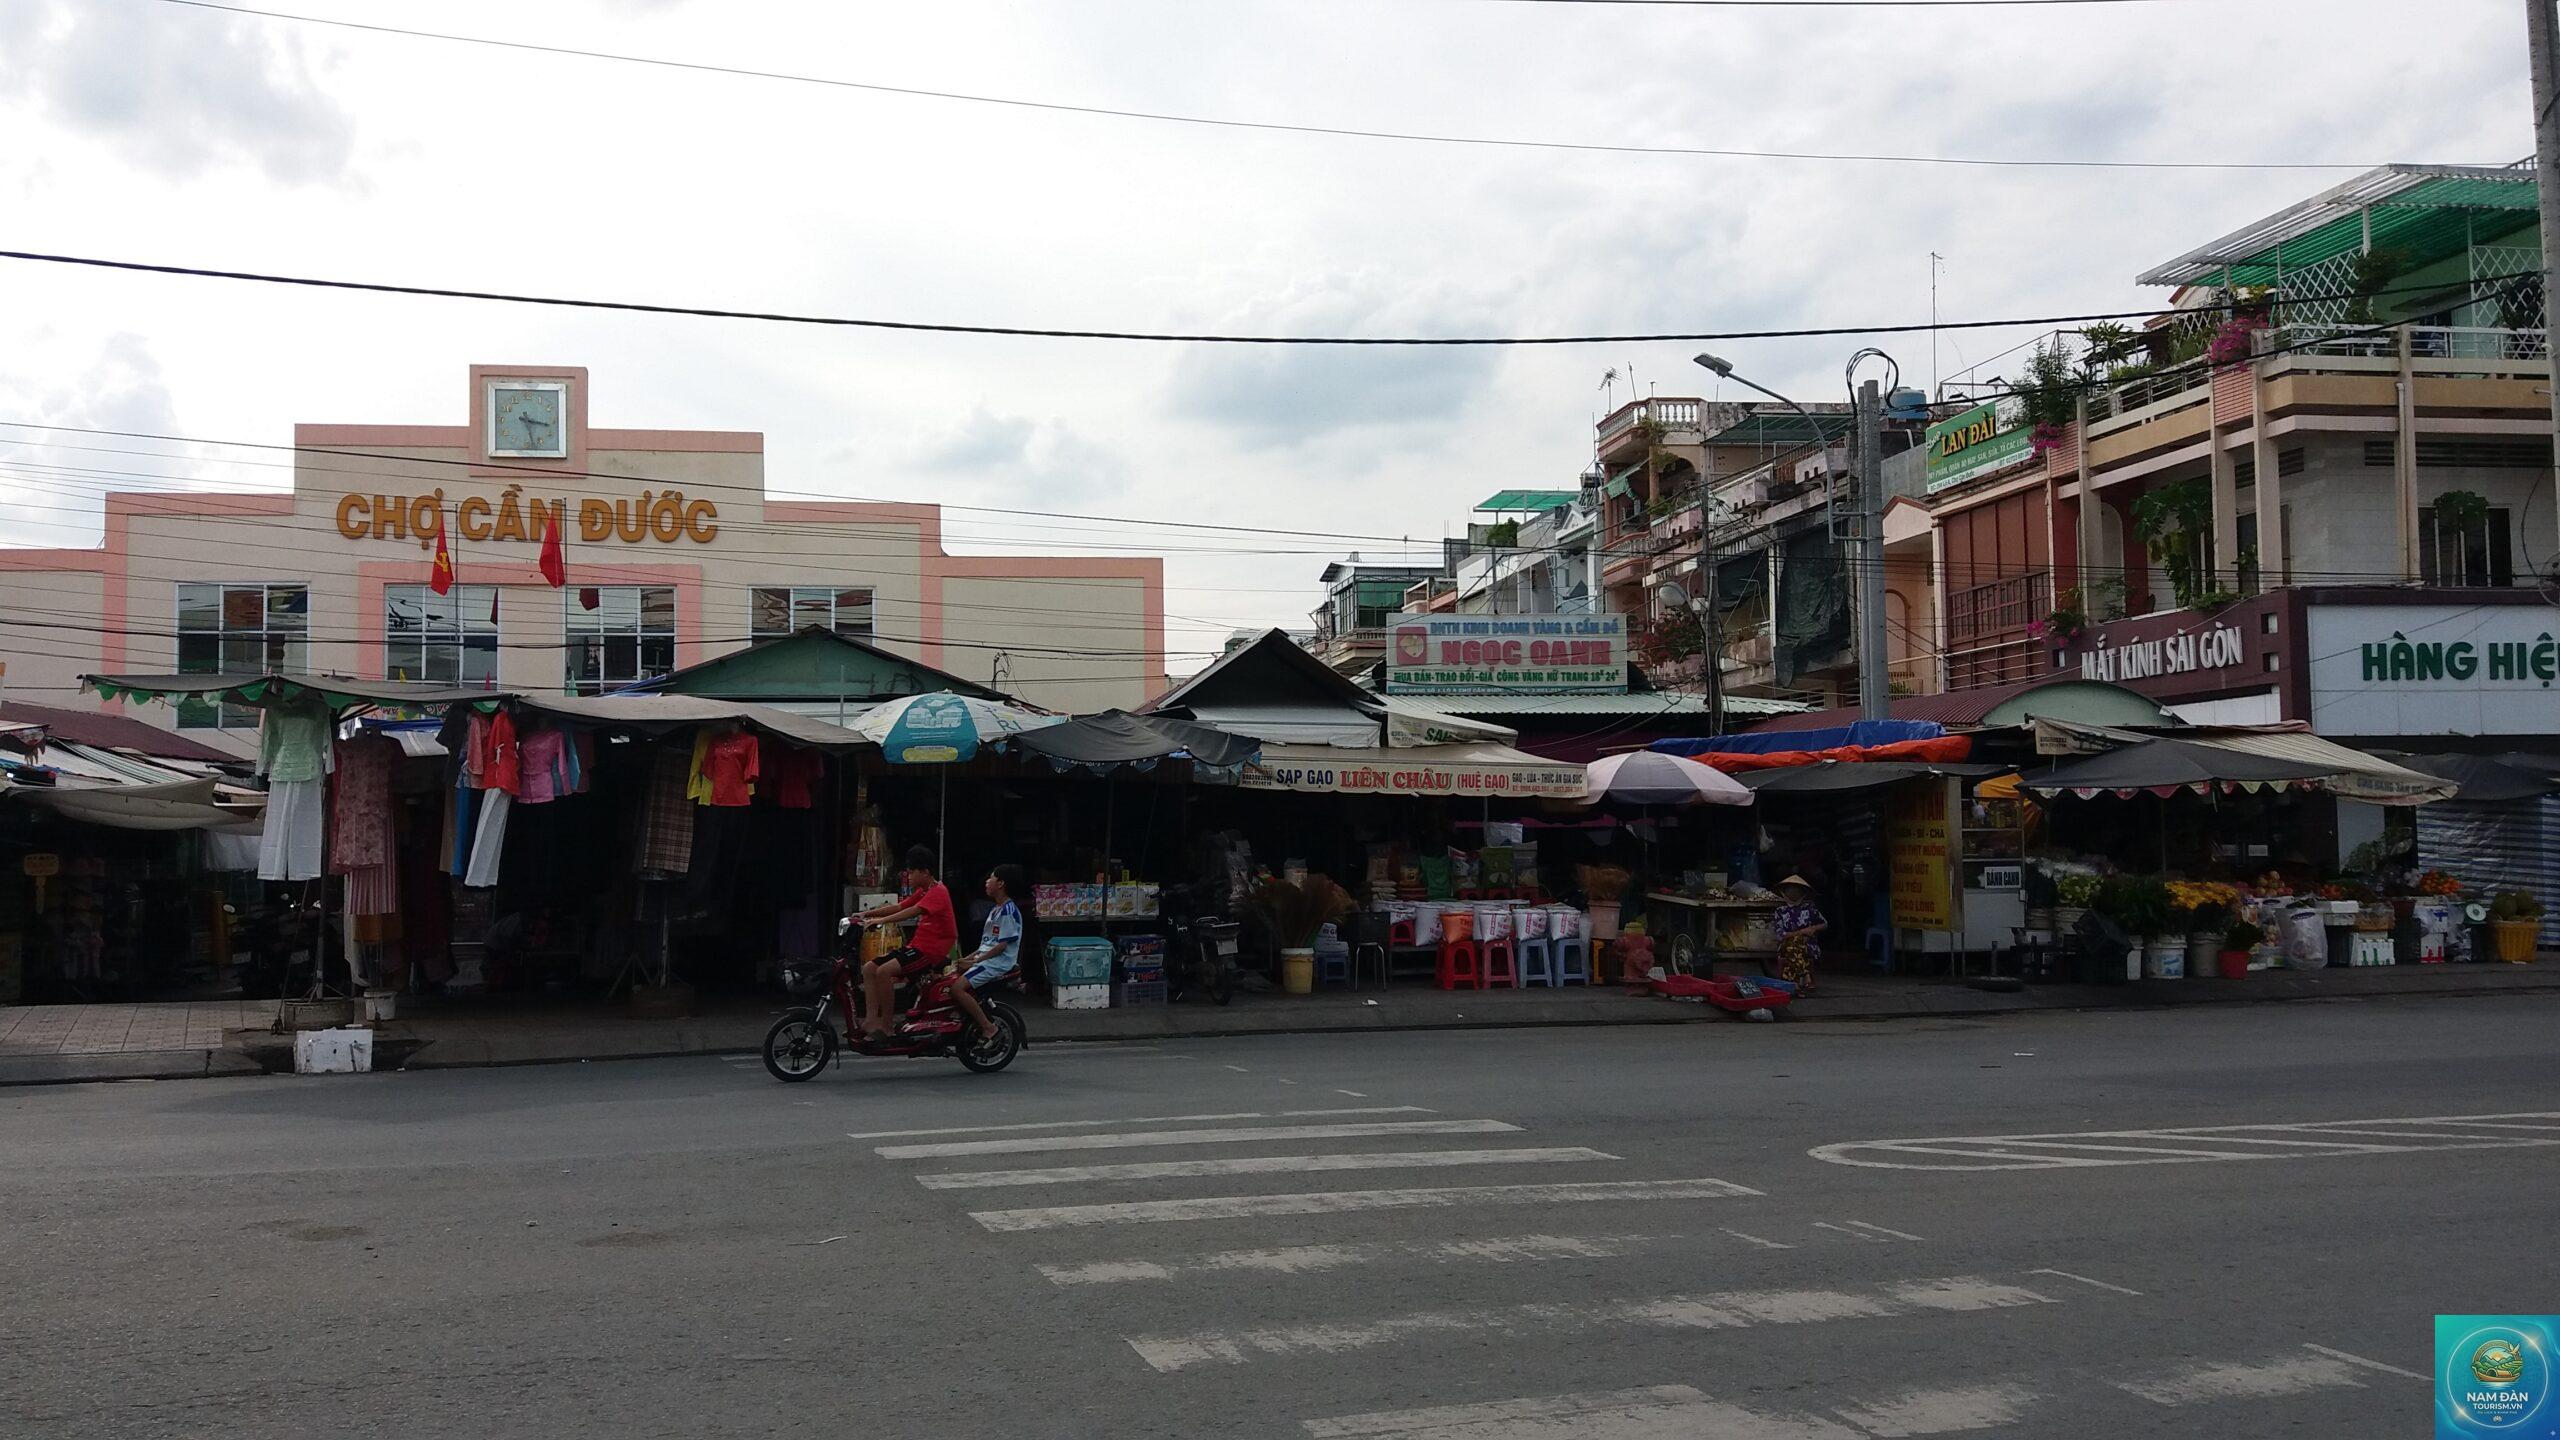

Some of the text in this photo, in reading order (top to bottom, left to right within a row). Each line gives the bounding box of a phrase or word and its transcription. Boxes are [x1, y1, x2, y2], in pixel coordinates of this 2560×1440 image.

[1941, 427, 1968, 457] LAN
[1969, 411, 1996, 445] ĐÀI
[336, 483, 719, 550] CHỢ CẦN ĐƯỚC
[1441, 640, 1611, 672] NGỌC OANH
[2081, 621, 2244, 682] MẮT KÍNH SÀI GÒN
[2362, 630, 2560, 688] HÀNG HIỆ
[1522, 669, 1543, 682] VÀNG
[1561, 671, 1589, 682] TRANG
[1276, 769, 1303, 788] SẠP
[1306, 770, 1334, 789] GẠO
[1339, 766, 1390, 788] LIÊN
[1392, 767, 1453, 790] CHÂU
[1484, 773, 1510, 792] GẠO)
